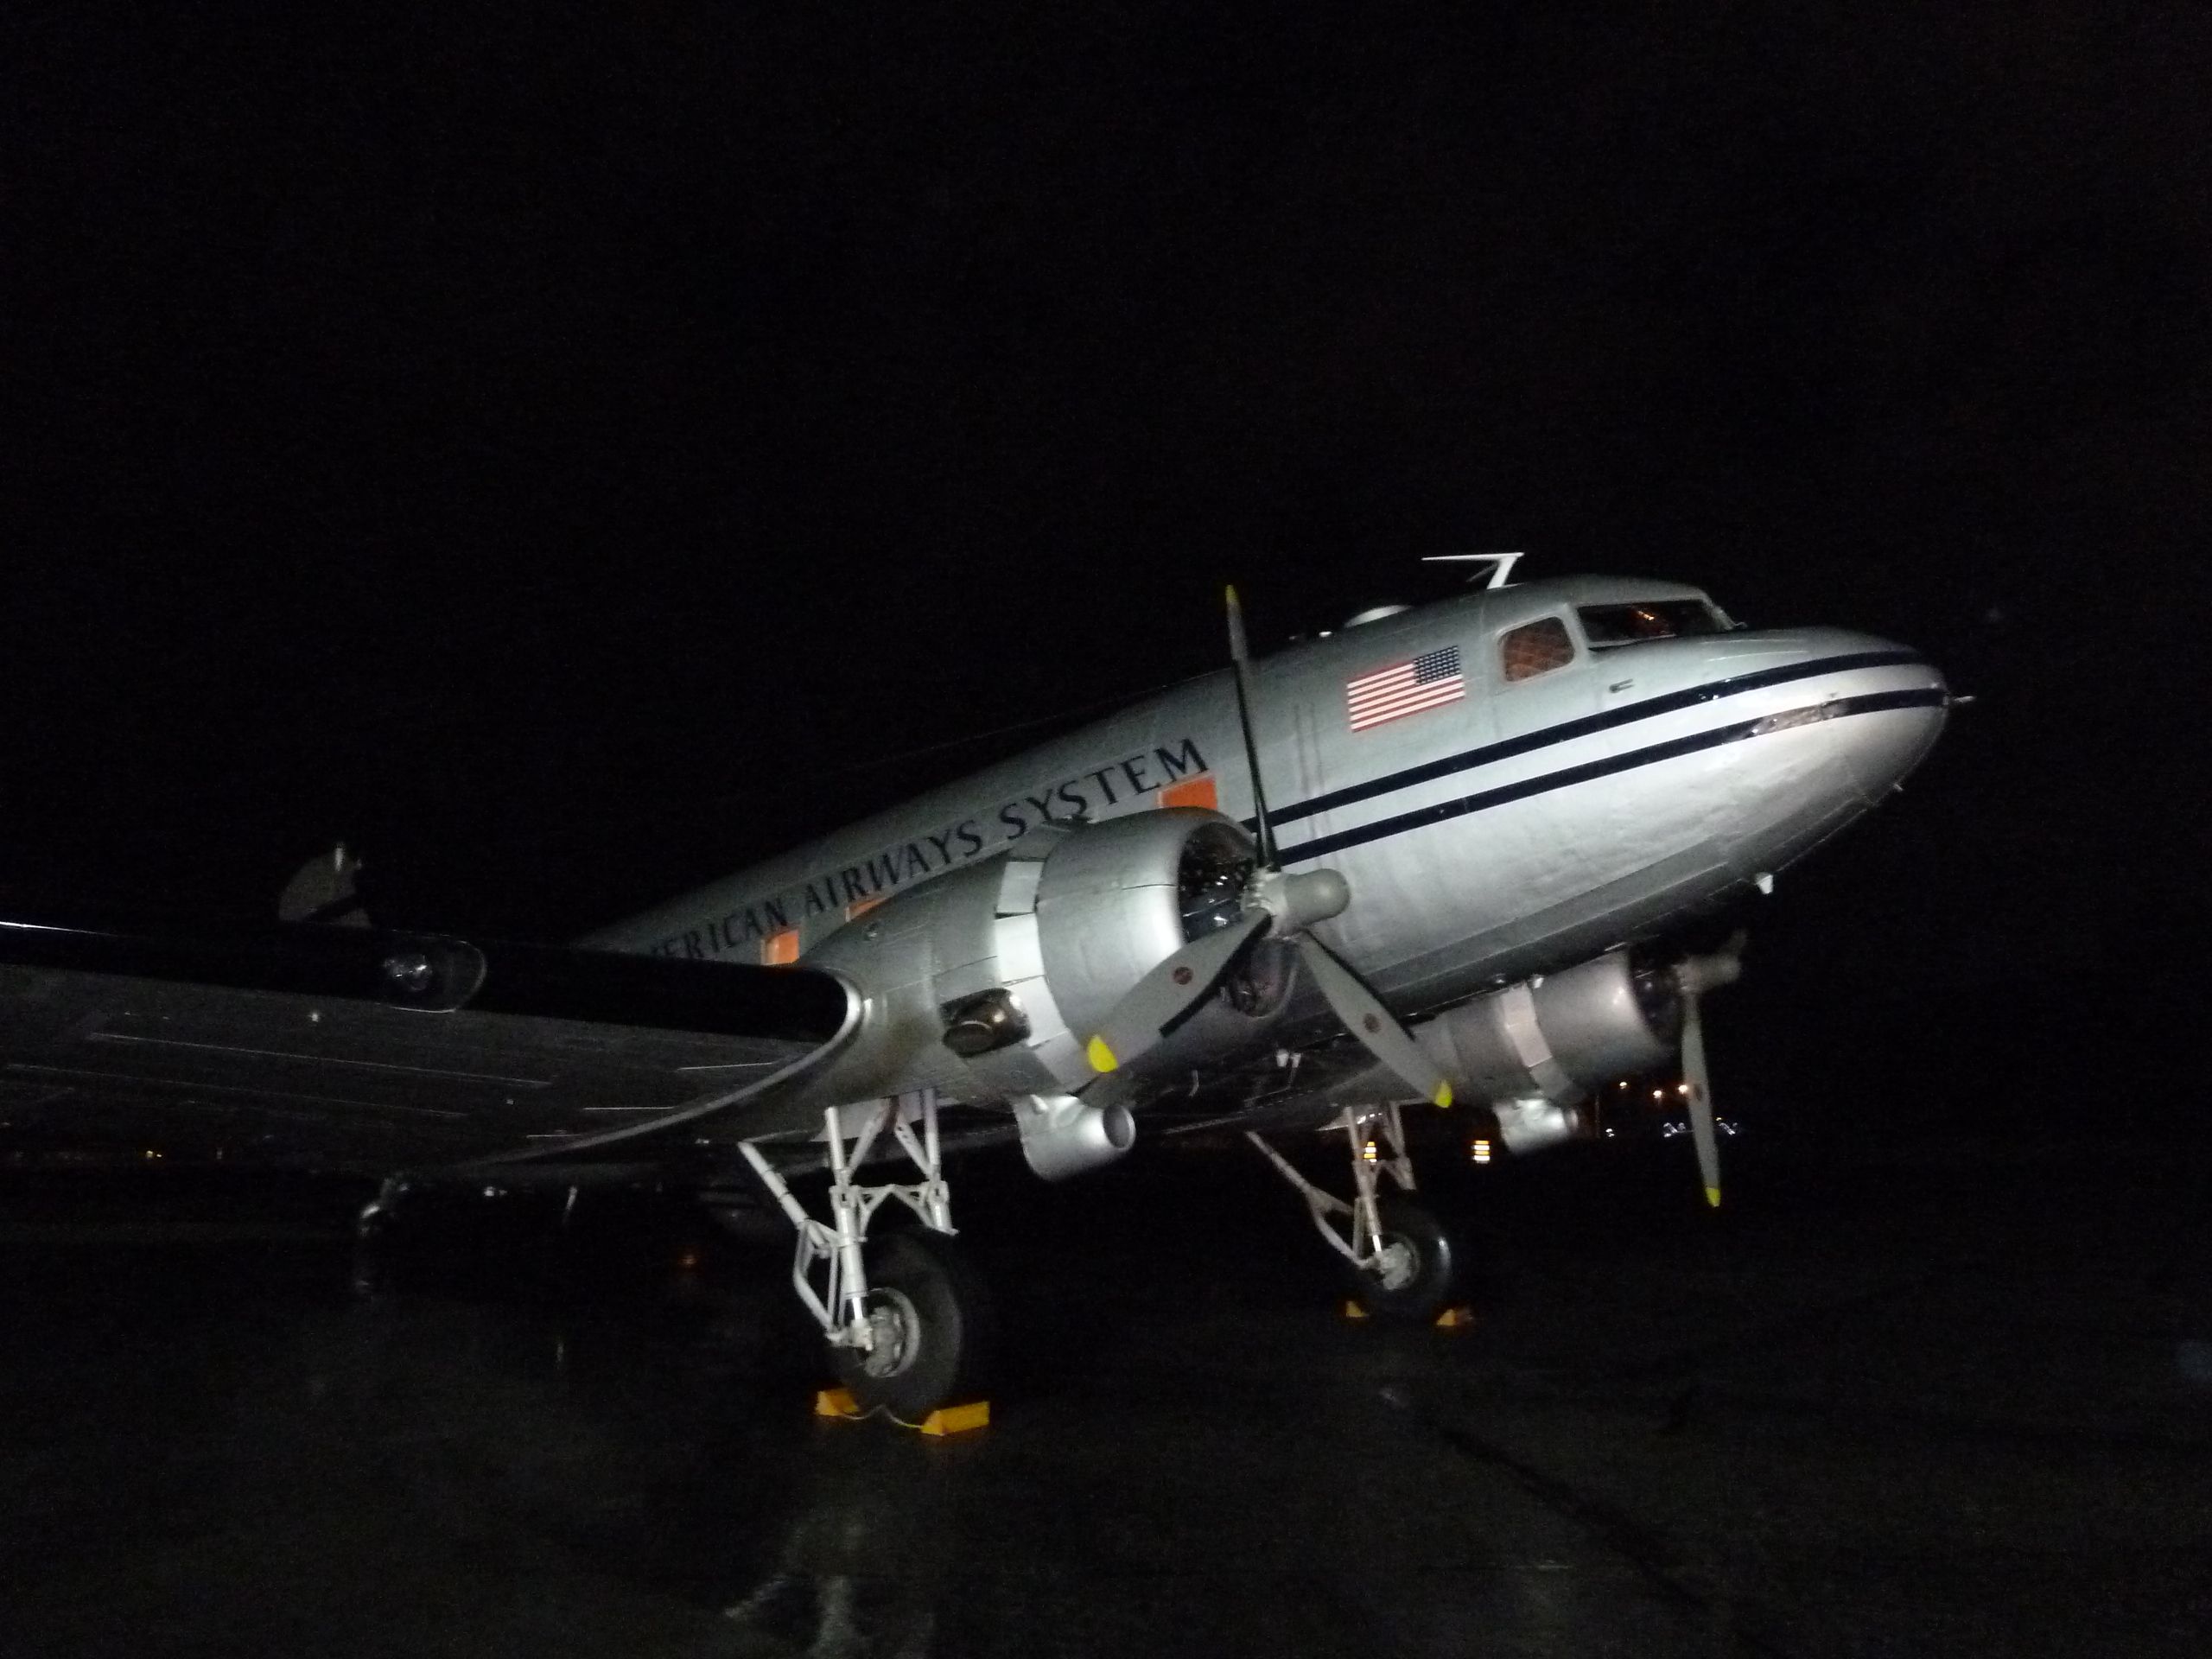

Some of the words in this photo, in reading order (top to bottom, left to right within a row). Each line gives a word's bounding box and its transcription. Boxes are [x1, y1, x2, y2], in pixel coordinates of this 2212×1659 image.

[652, 898, 788, 958] ERICAN
[805, 820, 982, 917] AIRWAYS
[1000, 739, 1208, 840] SYSTEM
